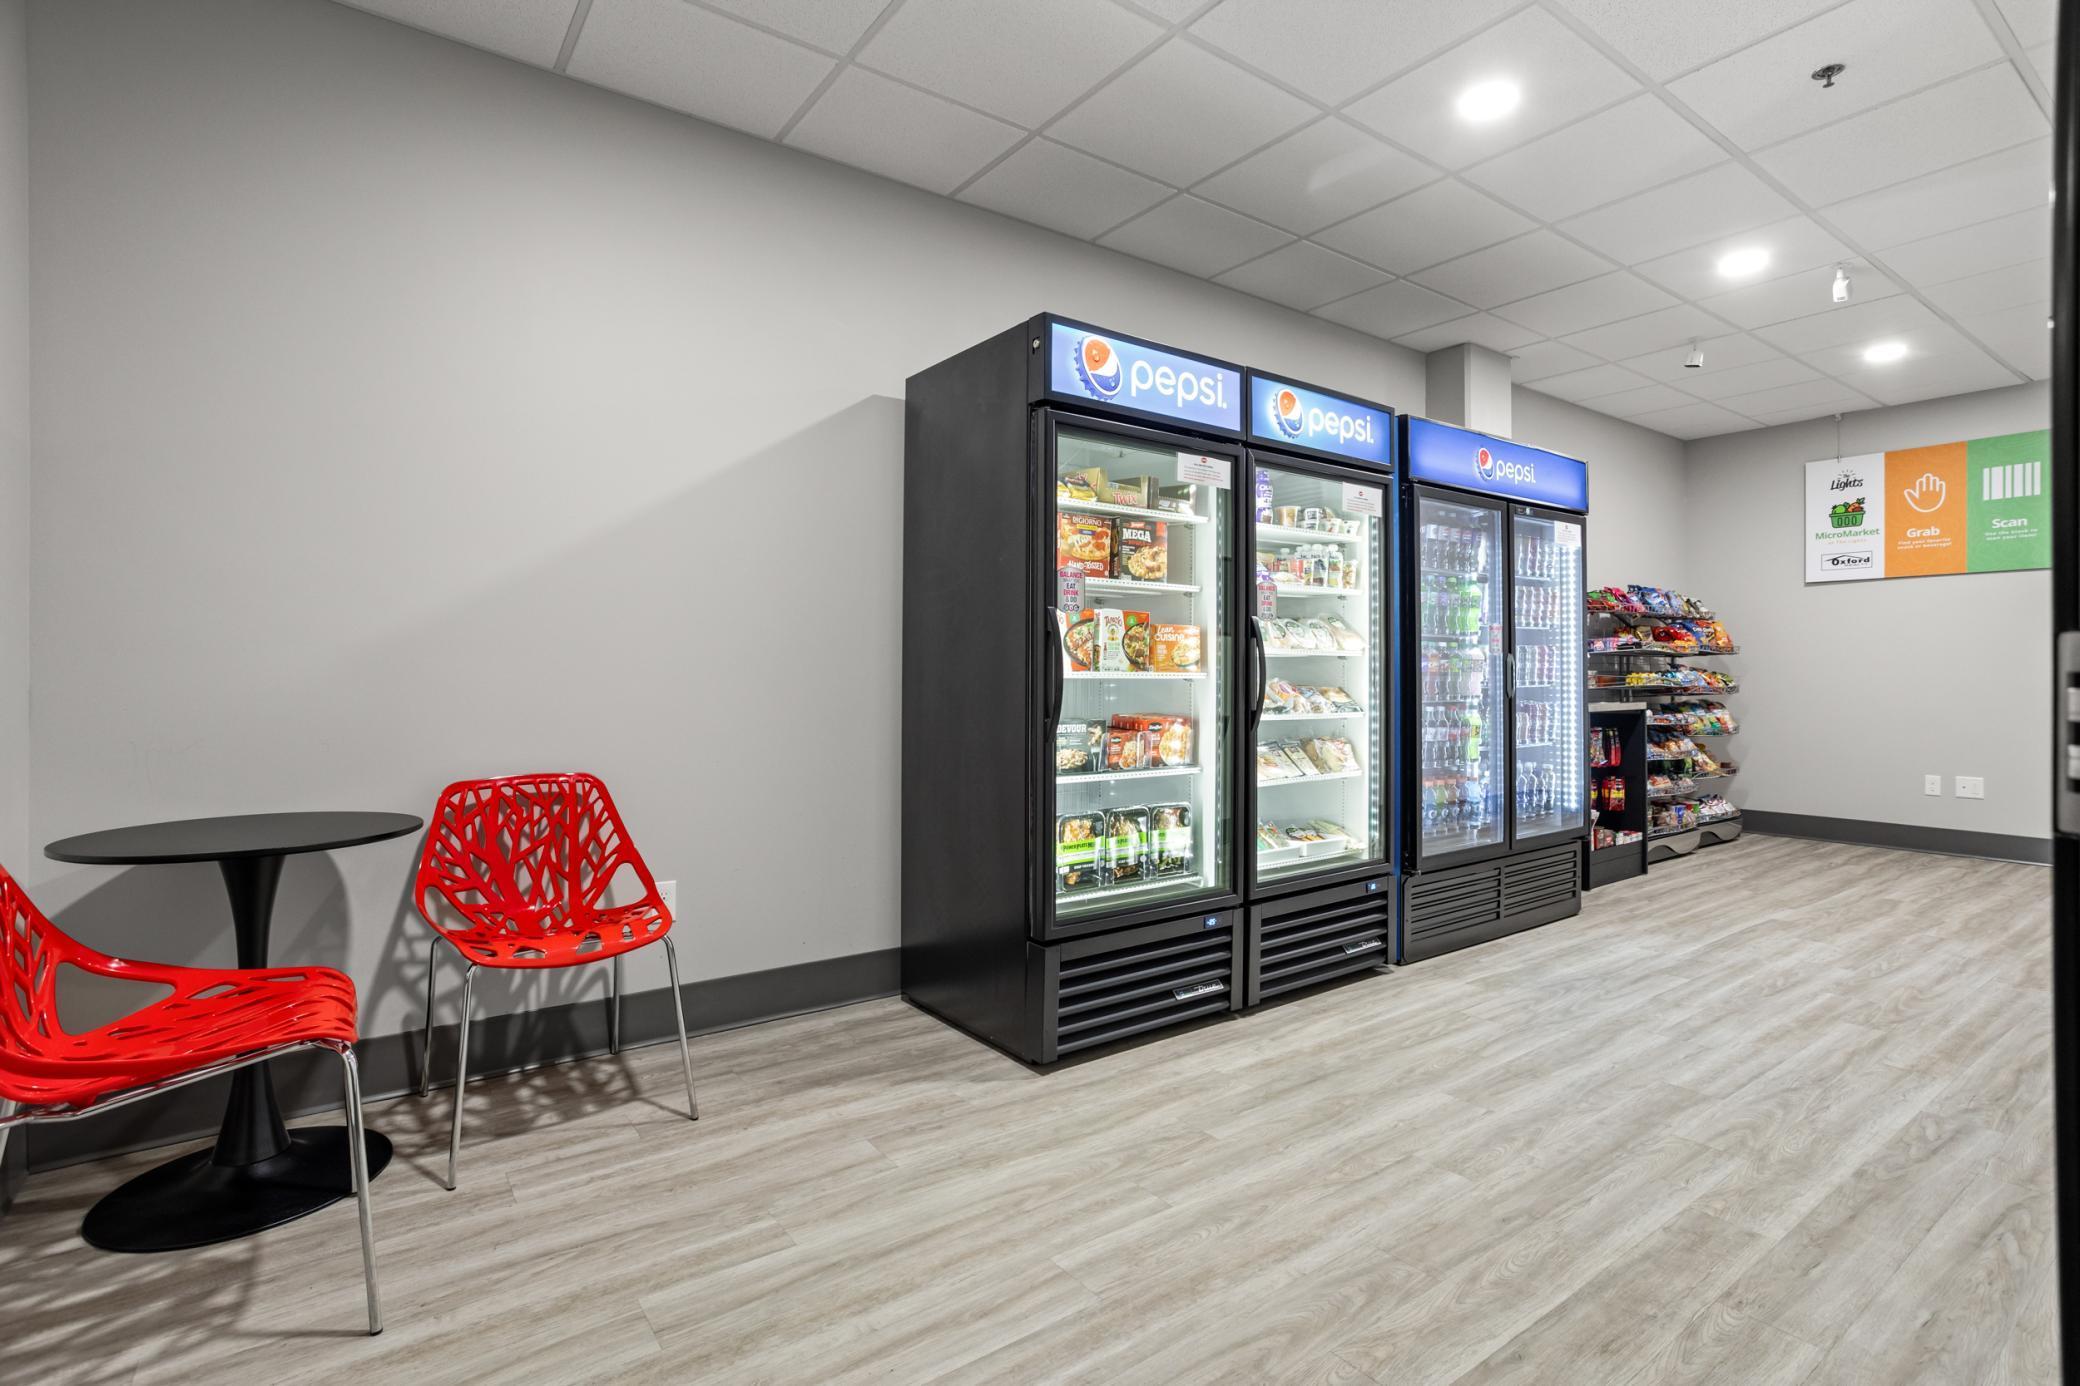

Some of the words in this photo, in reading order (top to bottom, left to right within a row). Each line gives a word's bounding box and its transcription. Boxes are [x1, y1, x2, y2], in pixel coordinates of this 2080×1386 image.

[1830, 478, 1864, 491] Lights
[1991, 518, 2028, 529] Scan
[1122, 528, 1152, 542] MEGA
[1815, 528, 1880, 540] MicroMarket
[1906, 525, 1940, 538] Grab
[1831, 556, 1870, 566] Oxford
[1056, 724, 1087, 733] DEVOUR
